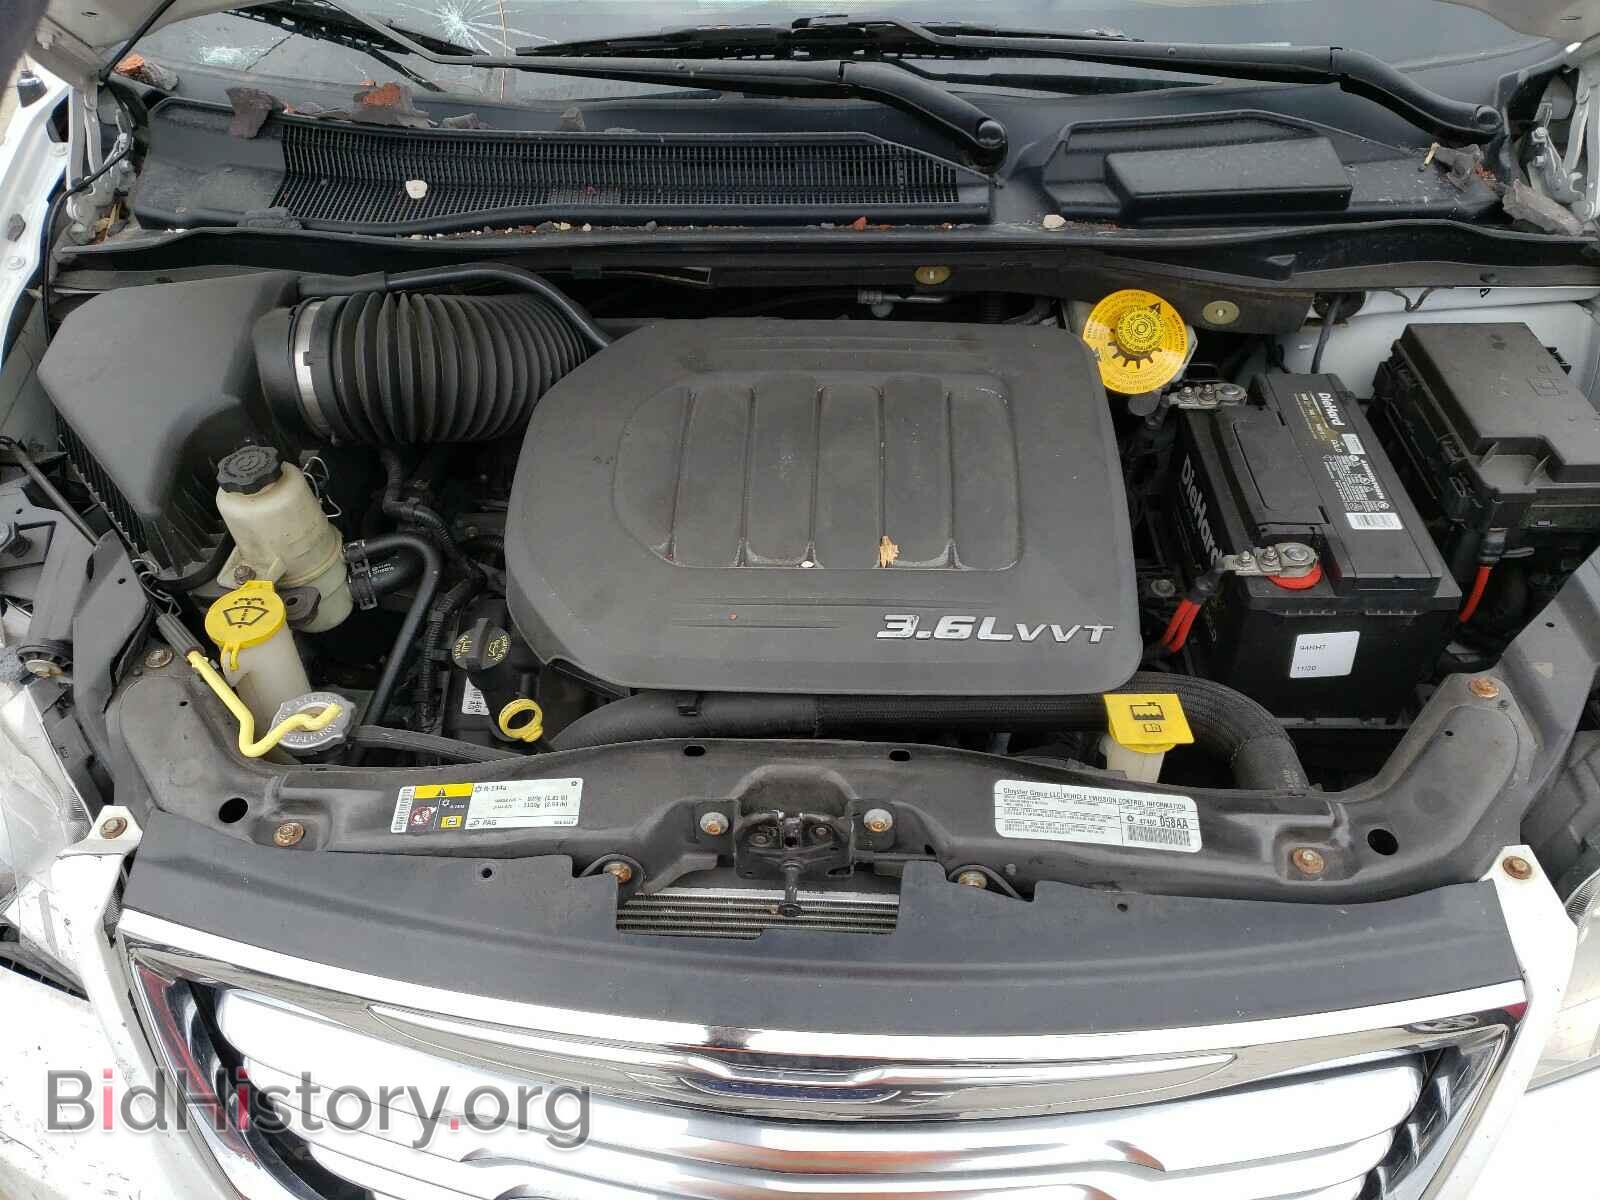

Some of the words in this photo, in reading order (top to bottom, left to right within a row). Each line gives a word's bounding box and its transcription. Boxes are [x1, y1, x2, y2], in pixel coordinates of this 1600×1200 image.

[1317, 392, 1346, 426] DieHard
[1003, 787, 1029, 797] Chrysler
[1030, 789, 1048, 799] Group
[1050, 791, 1061, 799] LLC
[1063, 792, 1087, 802] VEHICLE
[1089, 795, 1117, 804] EMISSION
[1118, 798, 1144, 807] CONTROL
[1146, 801, 1187, 811] INFORMATION
